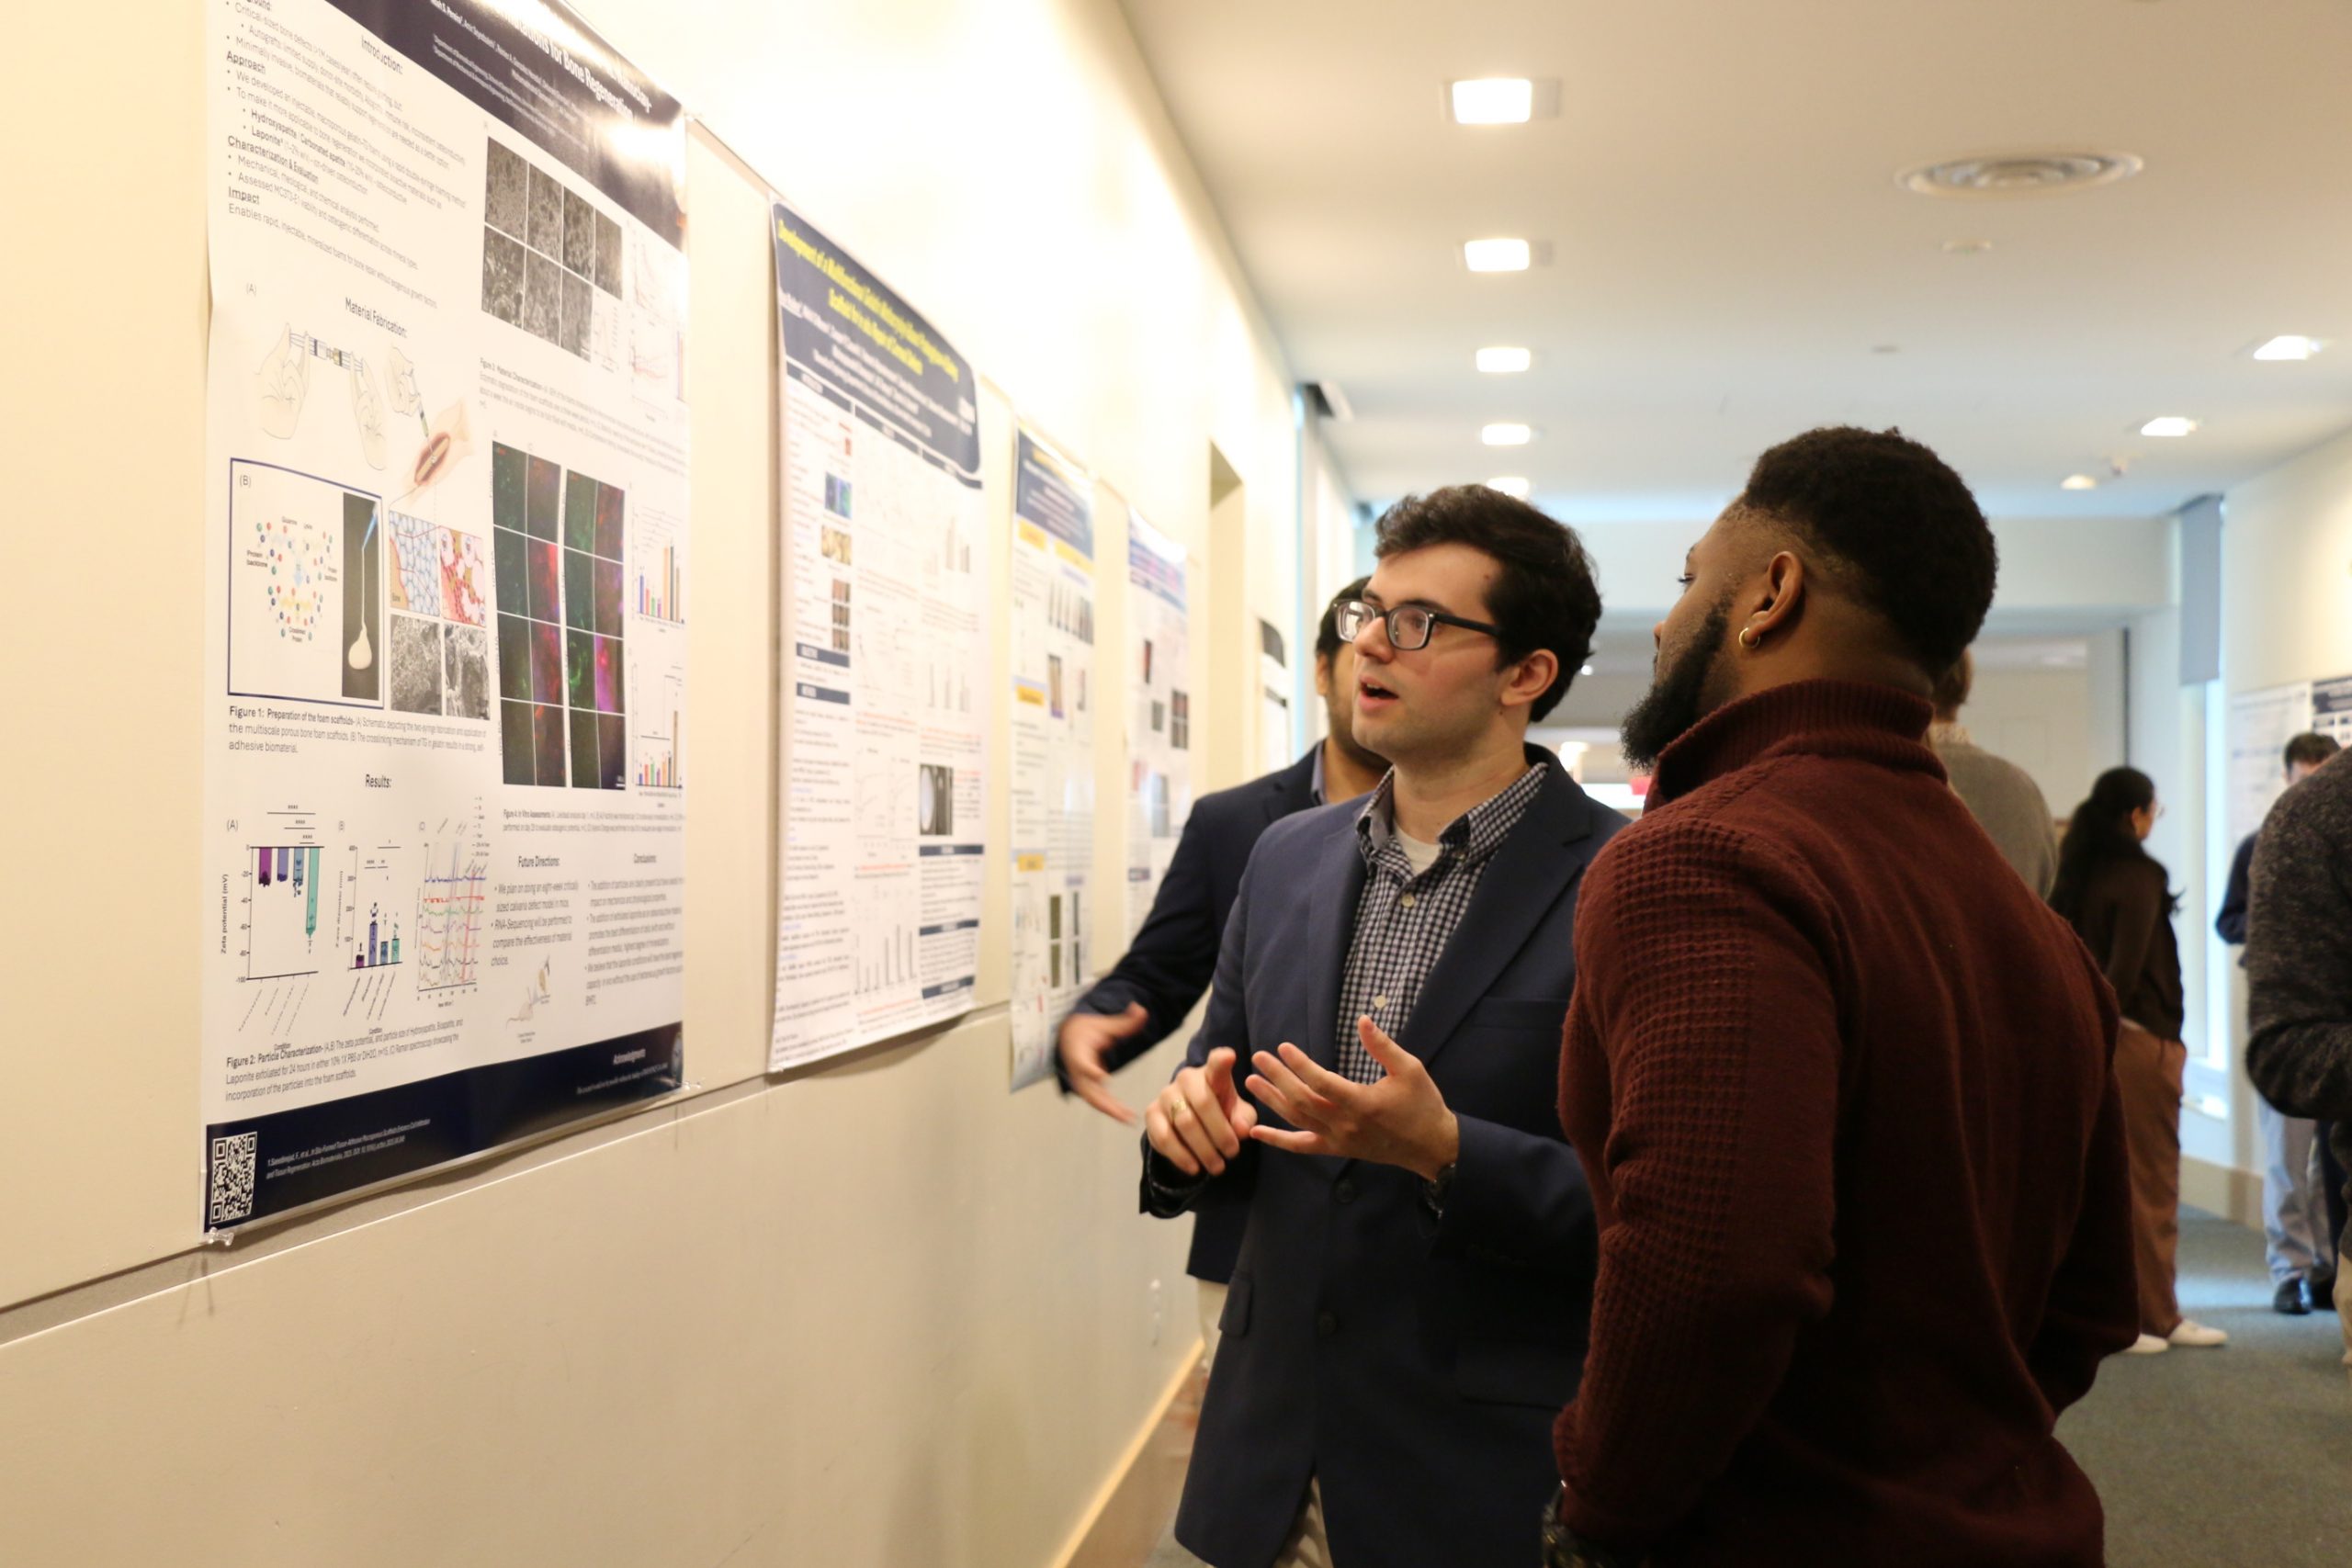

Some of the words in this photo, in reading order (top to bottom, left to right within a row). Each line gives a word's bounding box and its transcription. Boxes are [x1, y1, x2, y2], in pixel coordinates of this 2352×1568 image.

[227, 48, 265, 74] Approach
[362, 36, 402, 76] Introduction:
[236, 66, 248, 85] We
[563, 50, 584, 84] Bone
[586, 69, 632, 122] Regeneration
[227, 132, 288, 168] Characterization
[238, 170, 273, 193] Assessed
[228, 185, 259, 206] Impact
[229, 199, 261, 222] Enables
[245, 283, 257, 297] (A)
[345, 295, 371, 322] Material
[372, 308, 407, 339] Fabrication:
[240, 475, 251, 488] (B)
[230, 704, 255, 720] Figure
[267, 707, 300, 723] Preparation
[229, 722, 243, 734] the
[244, 722, 279, 736] multiscale
[229, 738, 263, 751] adhesive
[365, 773, 391, 788] Results:
[227, 818, 239, 831] (A)
[517, 855, 534, 867] Future
[227, 1053, 248, 1071] Figure
[257, 1049, 278, 1064] Particle
[226, 1067, 254, 1087] Laponite
